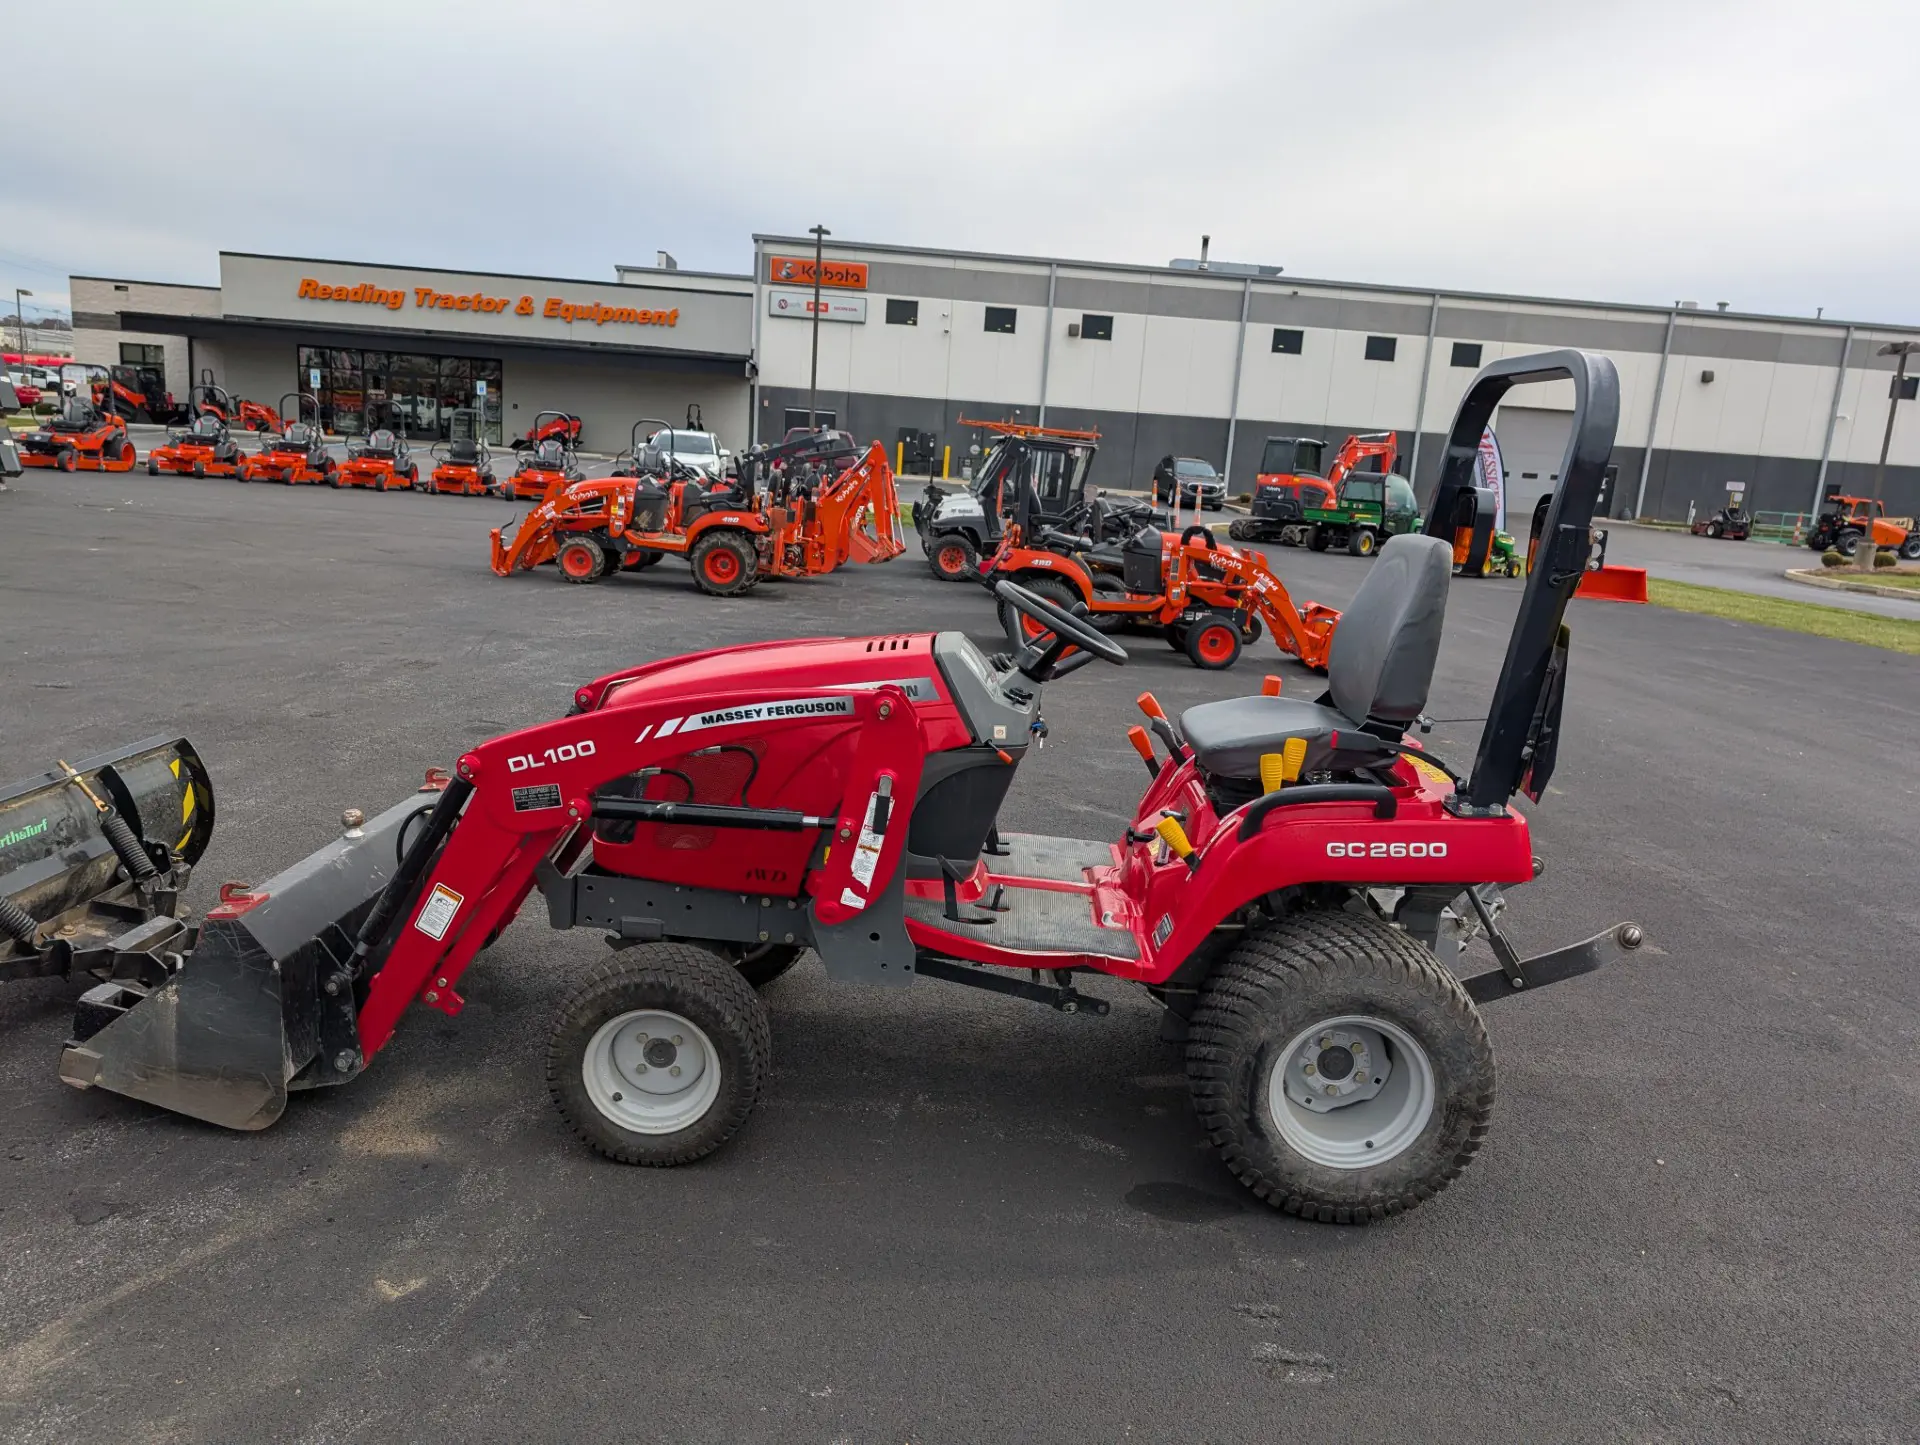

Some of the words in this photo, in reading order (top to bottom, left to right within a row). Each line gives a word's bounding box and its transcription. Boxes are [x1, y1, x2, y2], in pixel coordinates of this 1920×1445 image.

[297, 278, 406, 310] Reading
[414, 287, 510, 313] Tractor
[514, 295, 535, 316] &
[543, 297, 680, 328] Equipment
[568, 489, 599, 501] Kubota
[1208, 552, 1242, 570] Kubota
[700, 708, 763, 726] MASSEY
[766, 701, 847, 718] FERGUSON
[507, 740, 596, 773] DL100
[0, 817, 47, 849] rth&Turf
[1326, 842, 1448, 858] GC2600
